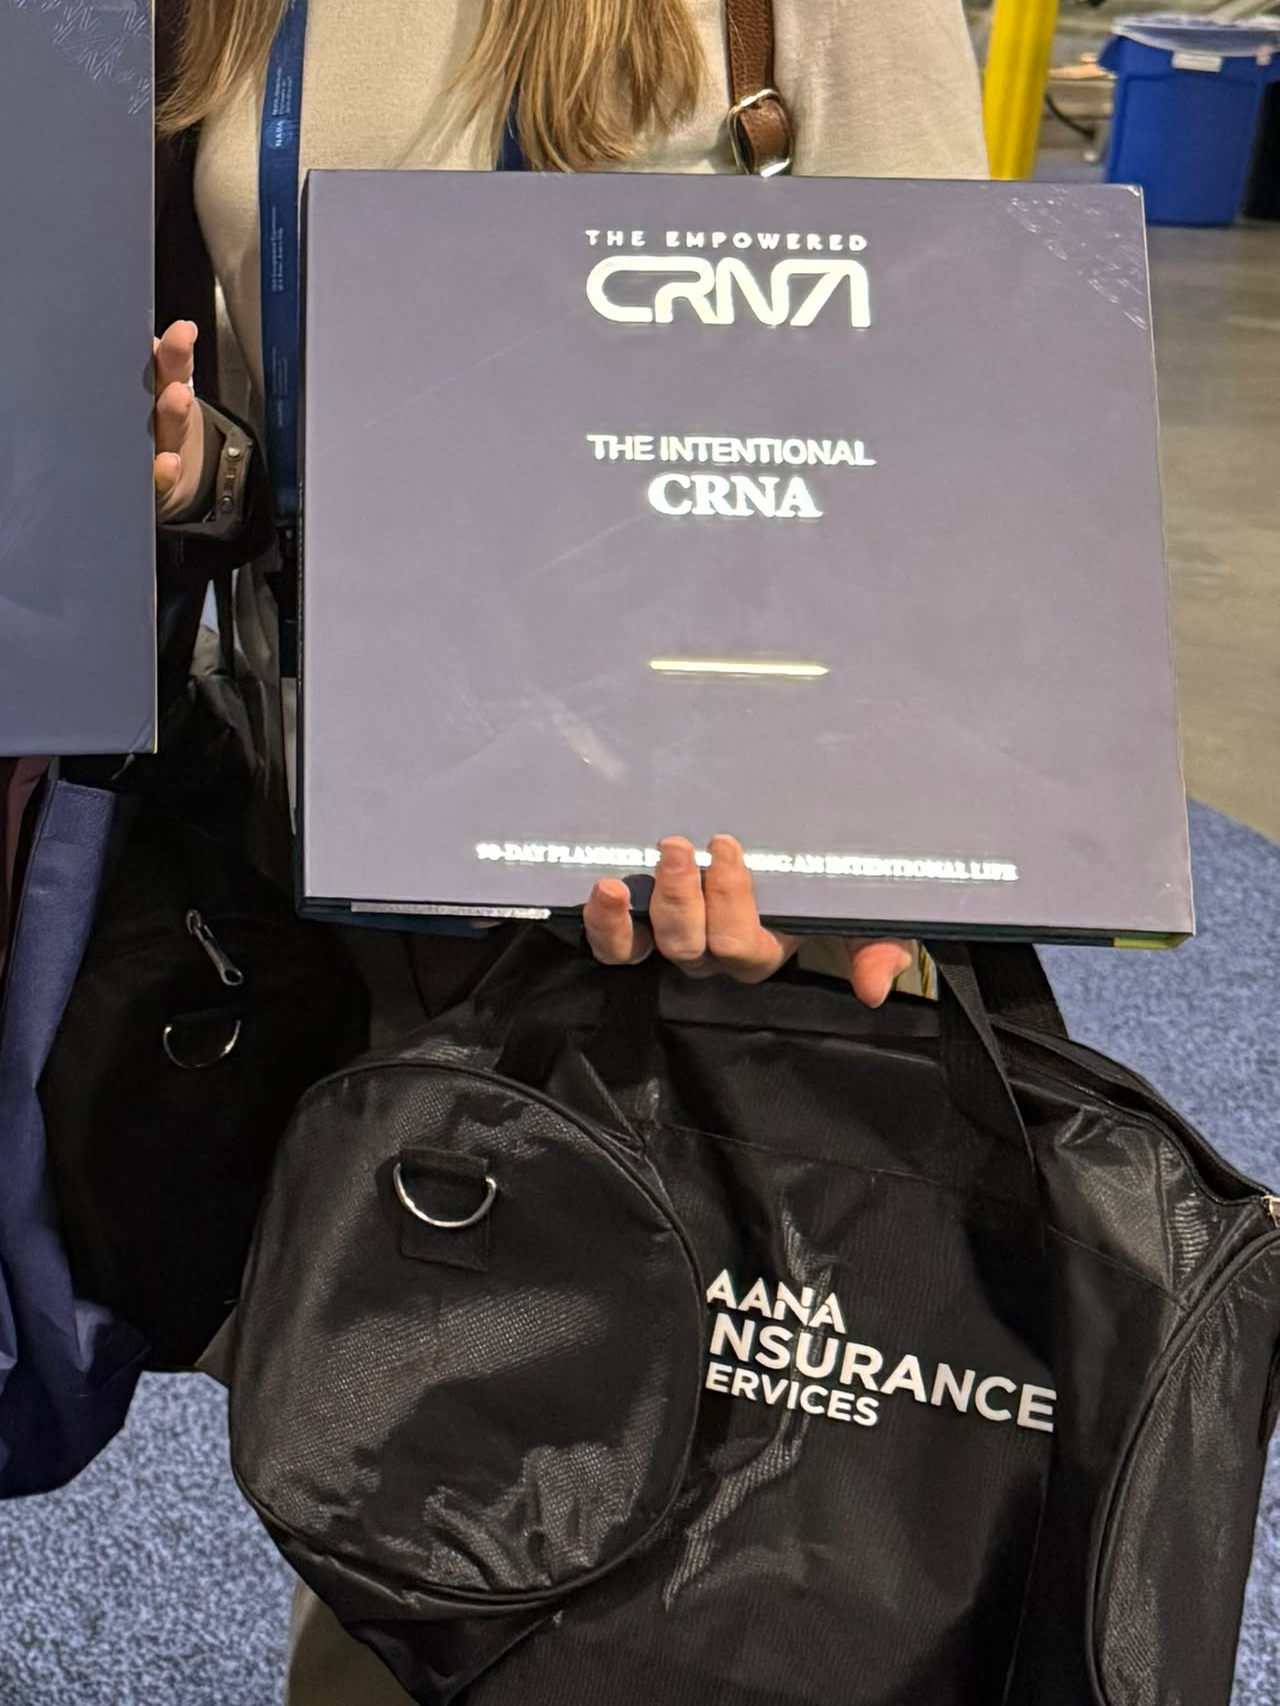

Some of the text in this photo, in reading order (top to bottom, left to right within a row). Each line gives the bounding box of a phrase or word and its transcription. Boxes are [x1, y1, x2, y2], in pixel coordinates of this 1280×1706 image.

[585, 230, 867, 252] THE EMPOWERED
[586, 255, 871, 328] CRNA
[586, 435, 876, 466] THE INTENTIONAL
[647, 473, 824, 518] CRNA
[706, 1269, 846, 1334] AANA
[705, 1362, 879, 1427] ERVICES
[710, 1313, 1057, 1433] NSURANCE
